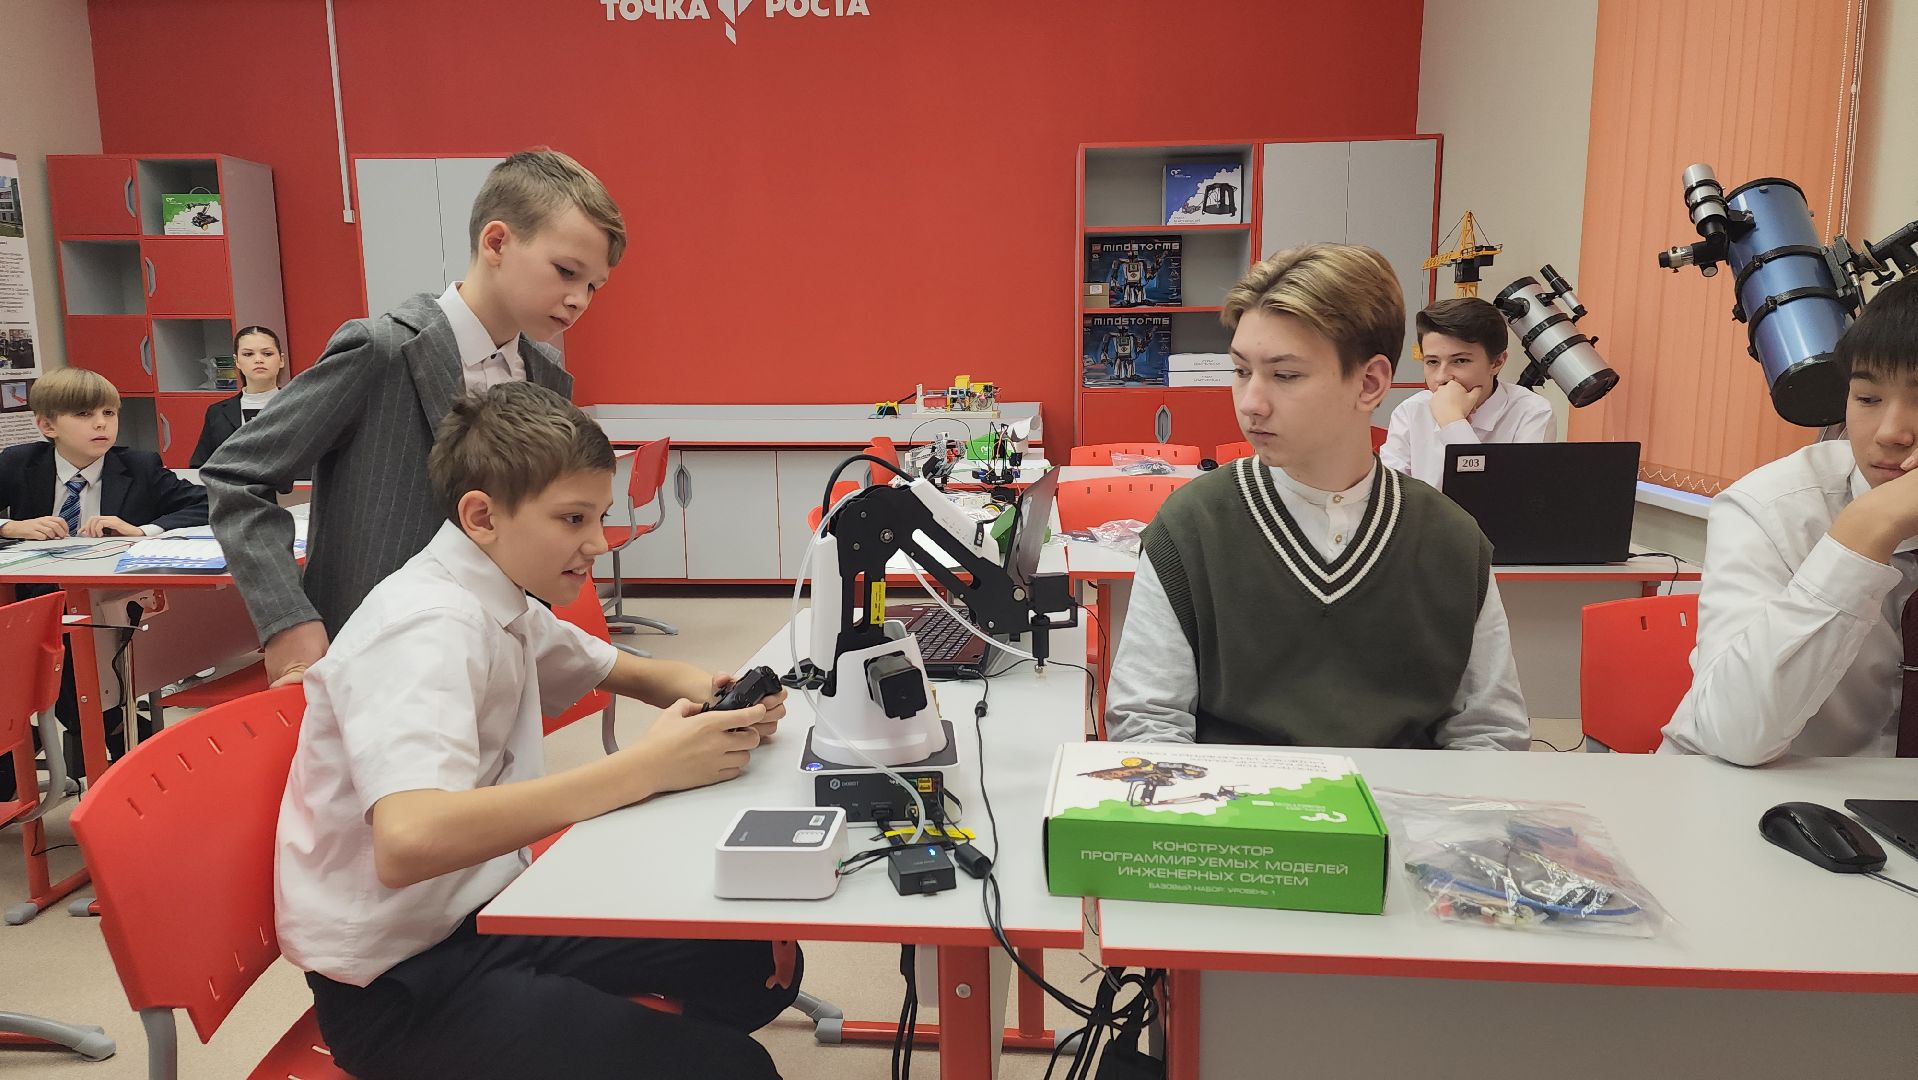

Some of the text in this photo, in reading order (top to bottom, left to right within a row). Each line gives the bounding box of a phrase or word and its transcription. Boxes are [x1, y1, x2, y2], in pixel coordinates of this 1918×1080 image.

[601, 0, 870, 20] ТОЧКА РОСТА
[1462, 458, 1479, 468] 203
[1152, 841, 1274, 856] КОНСТРУКТОР
[1081, 850, 1349, 875] ПРОГРАММИРУЕМЫХ МОДЕЛЕЙ
[1118, 866, 1309, 887] ИНЖЕНЕРНЫХ СИСТЕМ
